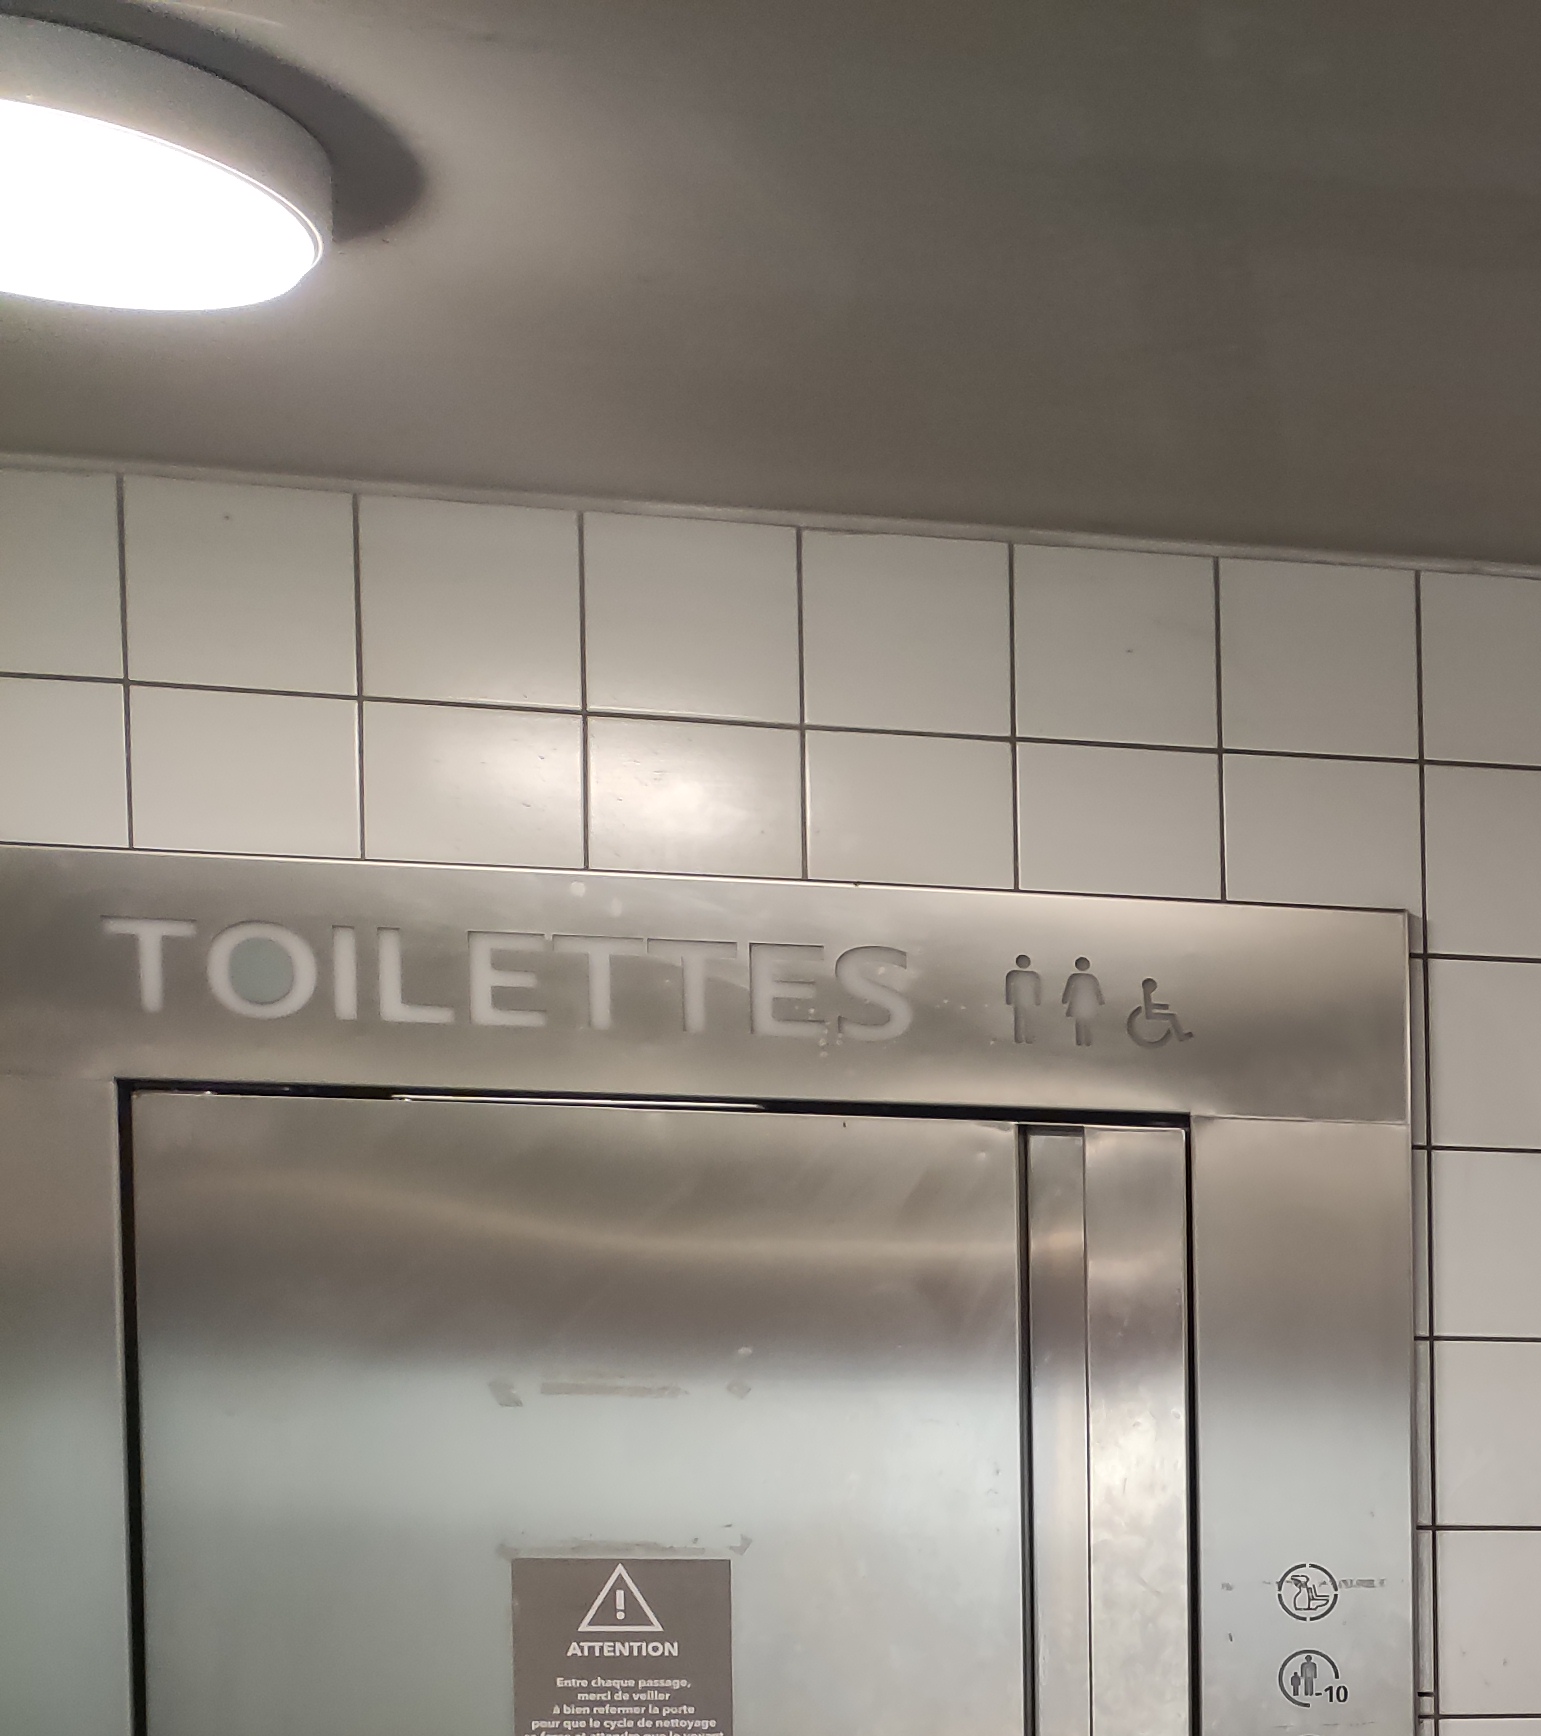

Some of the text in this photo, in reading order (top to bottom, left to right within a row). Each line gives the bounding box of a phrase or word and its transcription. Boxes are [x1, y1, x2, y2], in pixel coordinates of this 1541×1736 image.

[101, 914, 913, 1042] TOILETTES
[566, 1641, 679, 1657] ATTENTION
[556, 1676, 691, 1690] Entre chaque passage,
[577, 1690, 671, 1701] merci de veiller
[1314, 1685, 1349, 1704] -10
[563, 1703, 590, 1715] bien
[593, 1703, 646, 1715] refermer
[648, 1703, 660, 1714] la
[662, 1704, 695, 1717] porte
[531, 1717, 717, 1731] pour que le cycle de nettoyage
